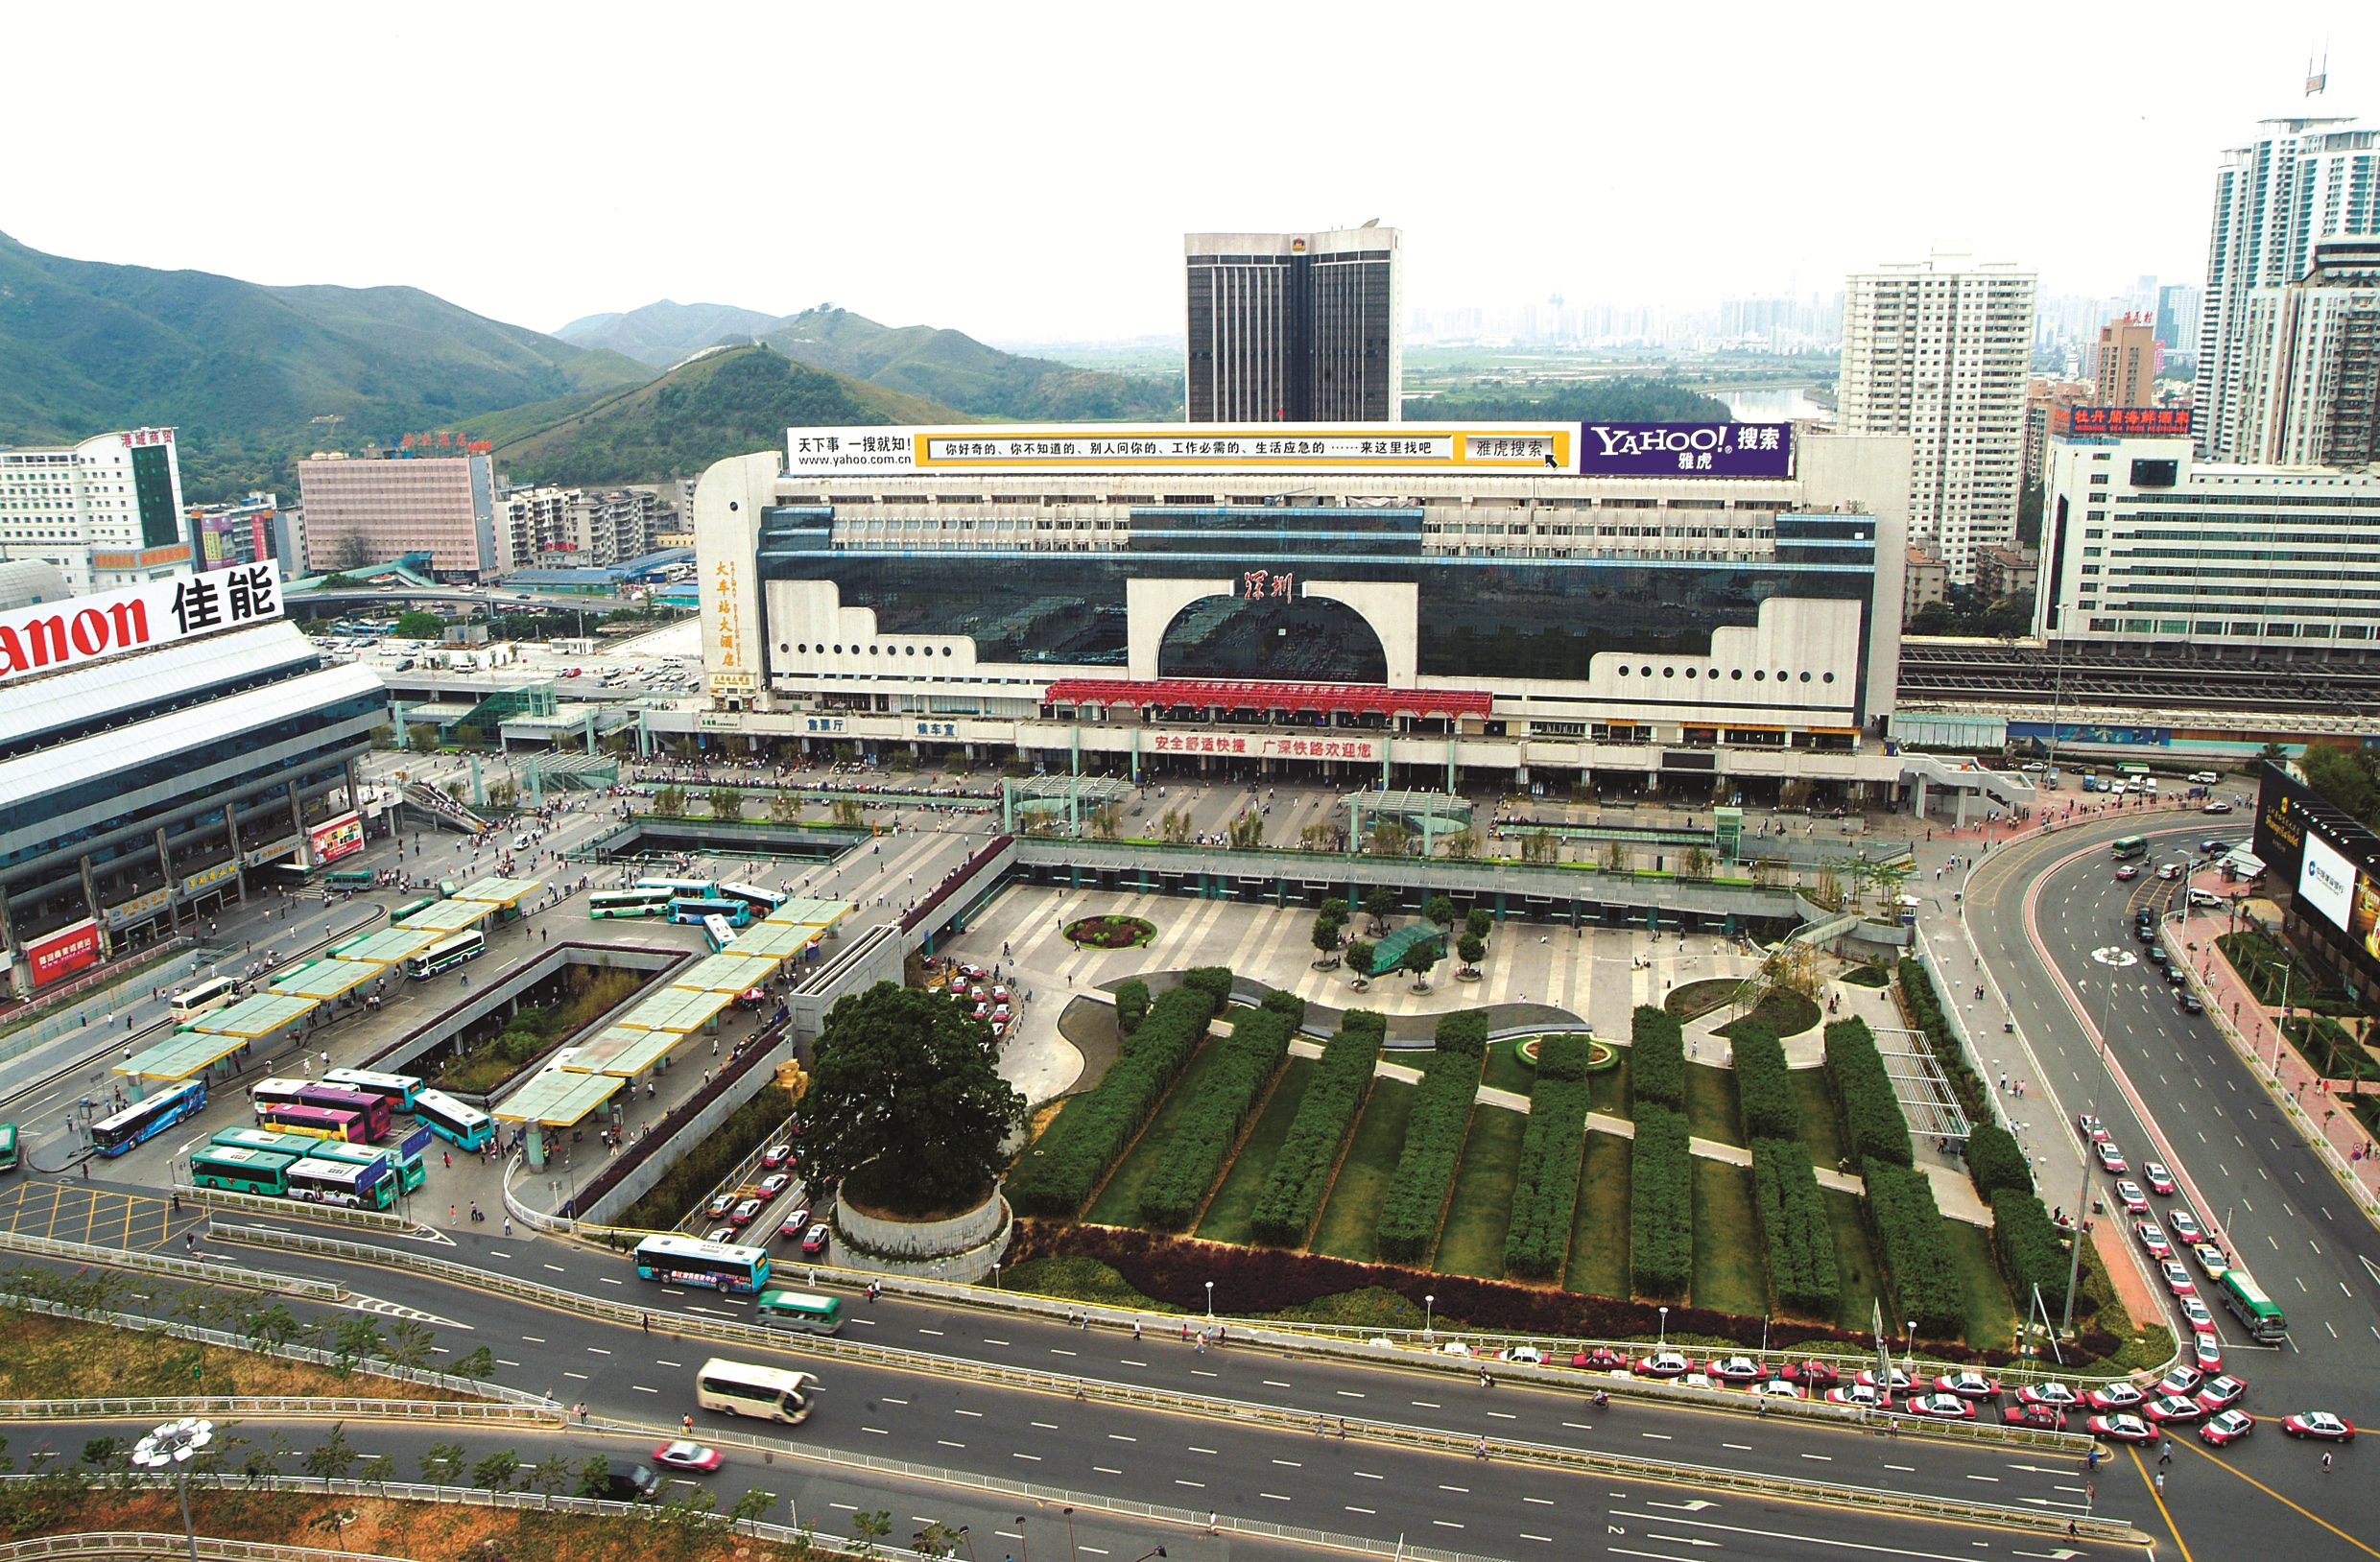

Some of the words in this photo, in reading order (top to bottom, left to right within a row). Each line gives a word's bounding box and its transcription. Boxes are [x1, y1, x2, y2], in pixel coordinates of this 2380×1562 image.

[798, 437, 839, 452] 天下事
[1738, 427, 1779, 450] 搜索
[1476, 439, 1543, 457] 雅虎搜索
[798, 455, 912, 466] www.yahoo.com.cn
[1678, 453, 1712, 470] 雅虎
[172, 565, 275, 634] 佳能
[807, 719, 844, 731] 售票厅
[916, 722, 955, 736] 候车室
[1154, 735, 1246, 753] 安全舒适快捷
[1262, 738, 1372, 758] 广深铁路欢迎您
[1607, 1525, 1626, 1535] 2
